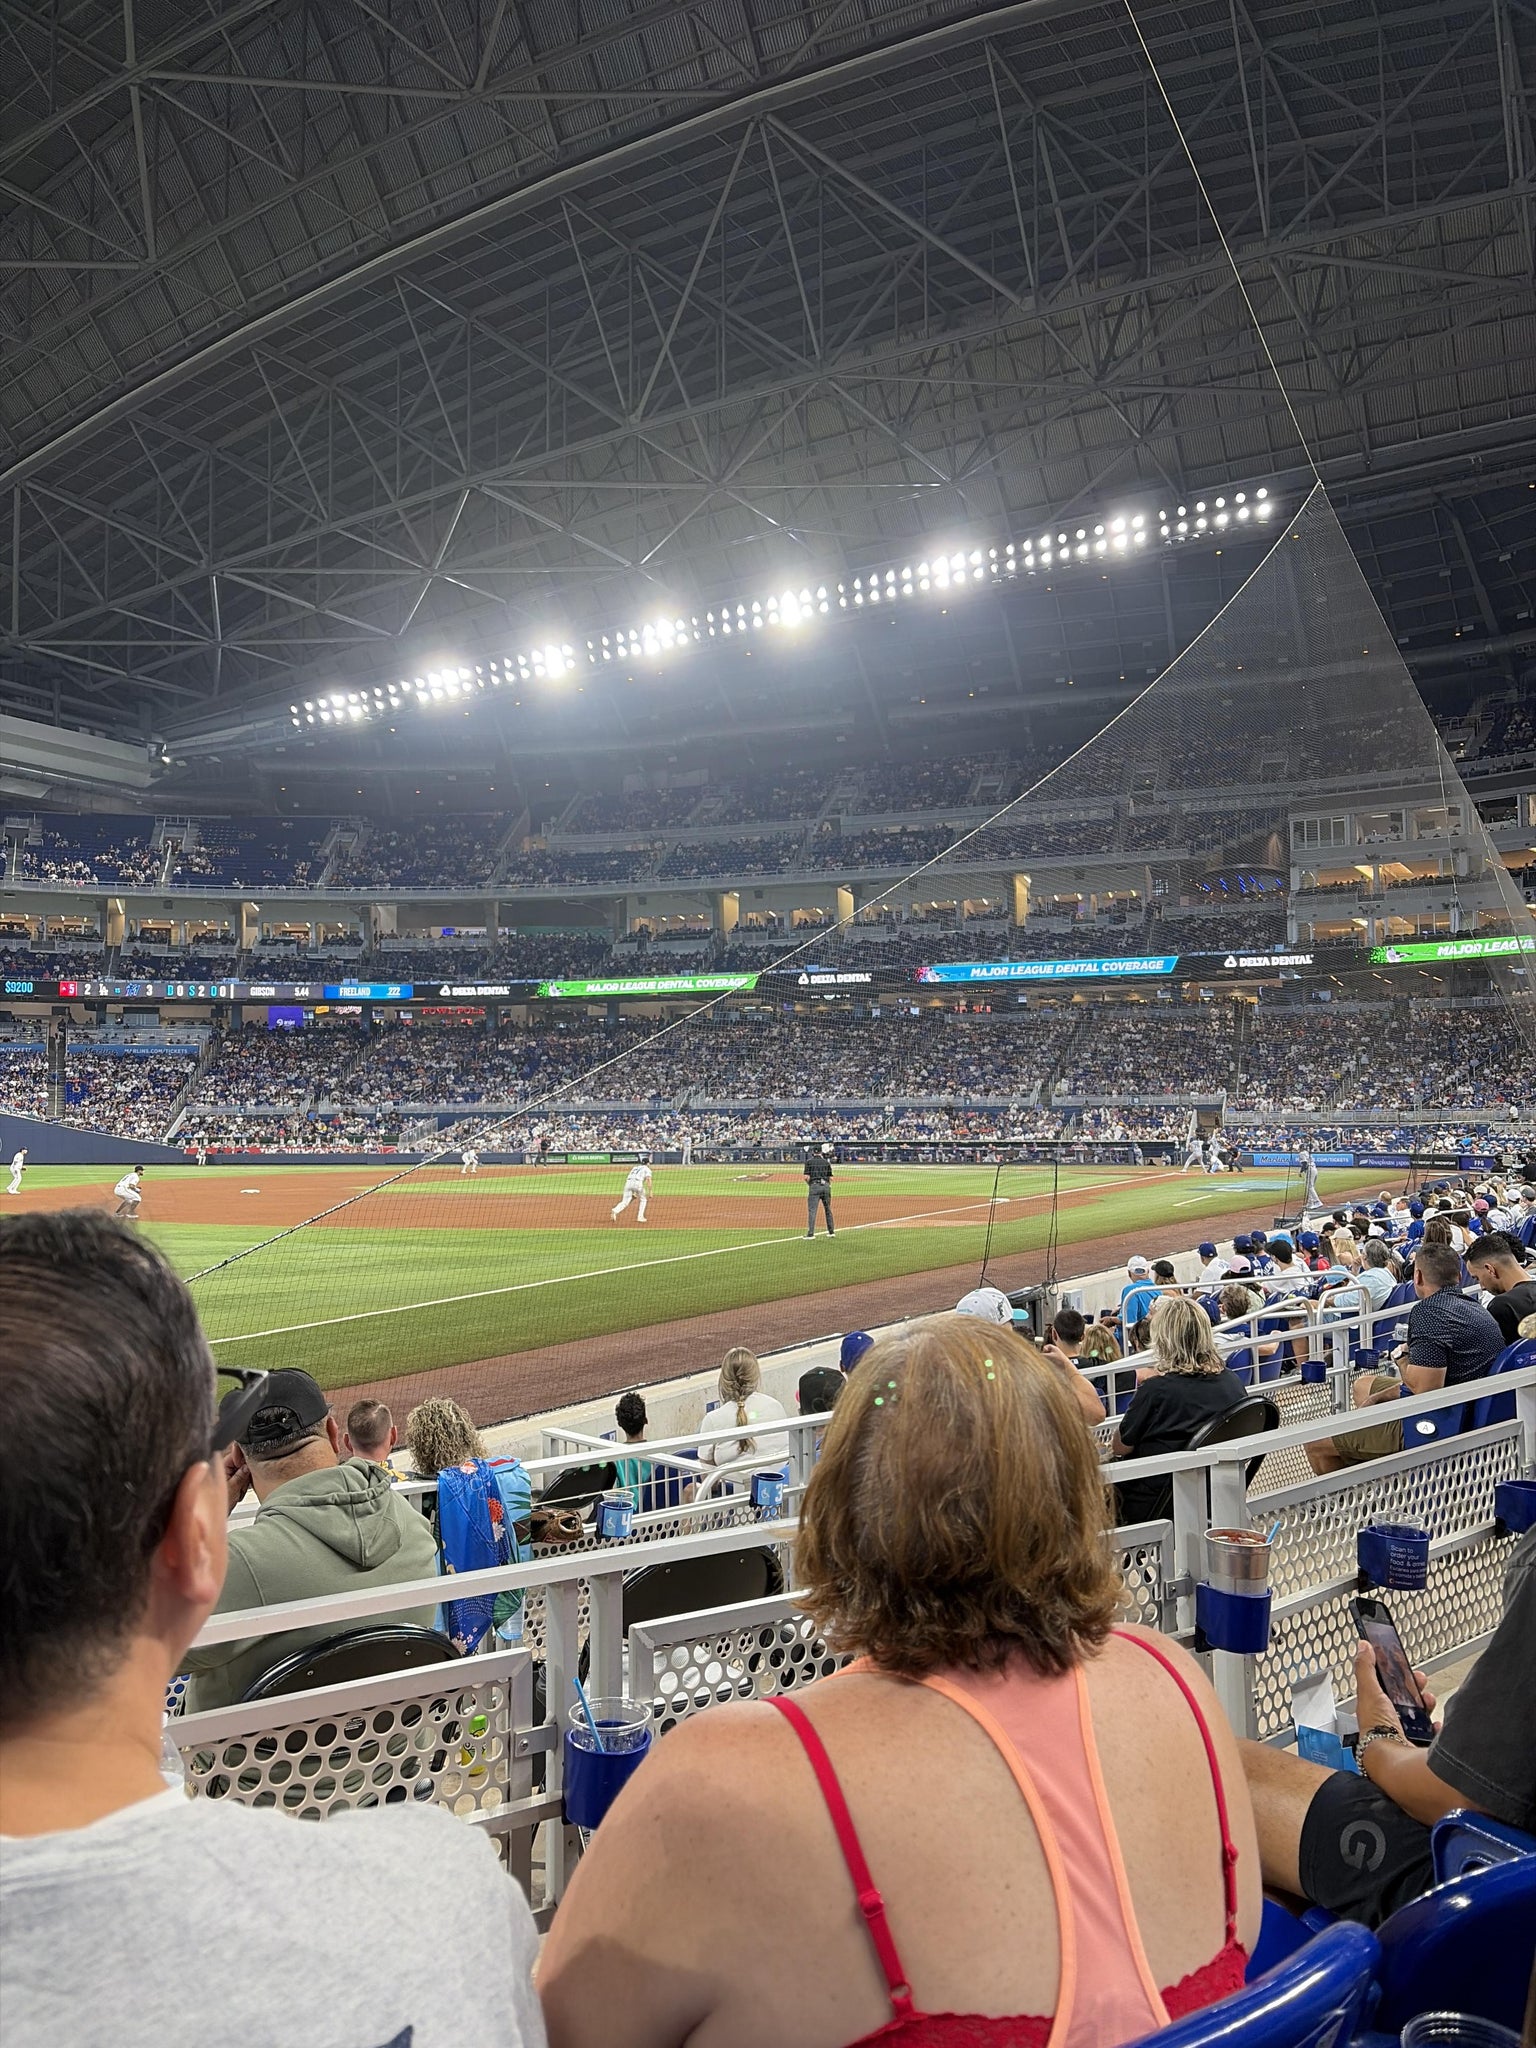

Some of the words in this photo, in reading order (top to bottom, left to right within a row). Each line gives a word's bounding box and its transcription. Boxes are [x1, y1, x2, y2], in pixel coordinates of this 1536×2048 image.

[1437, 943, 1482, 956] MAJOR
[1484, 939, 1535, 952] LEAGUE
[1239, 957, 1270, 967] DELTA
[1271, 955, 1312, 966] DENTAL
[970, 967, 1008, 977] MAJOR
[1010, 965, 1054, 975] LEAGUE
[1055, 963, 1099, 973] DENTAL
[1102, 960, 1164, 972] COVERAGE
[811, 975, 836, 984] DELTA
[837, 973, 871, 983] DENTAL
[5, 981, 33, 993] $9200
[69, 983, 75, 994] 5
[84, 983, 91, 995] 2
[146, 984, 153, 996] 3
[189, 985, 195, 996] S
[198, 985, 205, 996] 2
[250, 986, 275, 996] GIBSON
[340, 987, 371, 996] FREELAND
[452, 986, 477, 996] DELTA
[477, 985, 510, 995] DENTAL
[586, 982, 618, 992] MAJOR
[620, 981, 656, 991] LEAGUE
[658, 980, 694, 989] DENTAL
[1422, 1424, 1429, 1432] A
[774, 1483, 784, 1503] 3
[621, 1512, 632, 1533] 4
[1390, 1544, 1406, 1553] Scan
[1340, 1820, 1386, 1872] G
